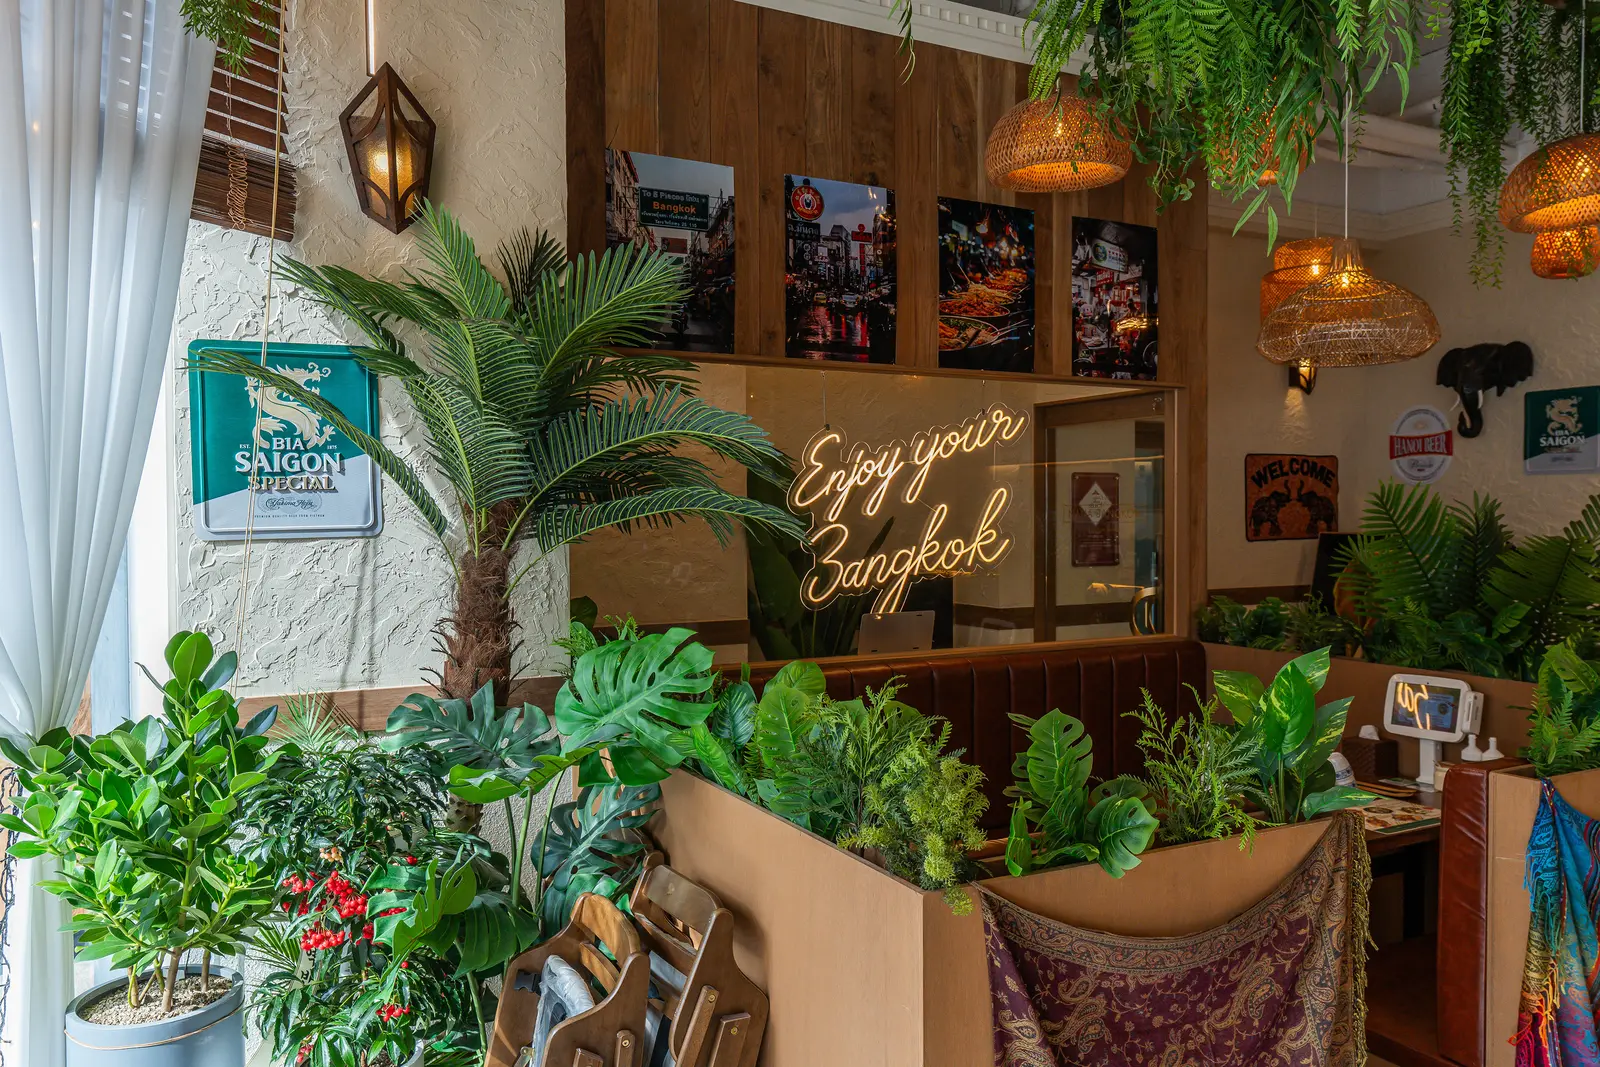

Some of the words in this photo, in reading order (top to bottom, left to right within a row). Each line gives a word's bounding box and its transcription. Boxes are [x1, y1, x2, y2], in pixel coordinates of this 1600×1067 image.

[652, 201, 697, 214] Bangkok
[272, 437, 305, 450] BIA
[1394, 437, 1423, 456] HANOI
[1424, 433, 1448, 454] BEER
[1539, 435, 1586, 447] SAIGON
[235, 451, 341, 473] SAIGON
[794, 433, 904, 522] Enjoy
[905, 409, 1025, 504] your
[1250, 457, 1336, 489] WELCOME
[248, 475, 336, 491] SPECIAL
[808, 487, 1010, 614] Bangkok
